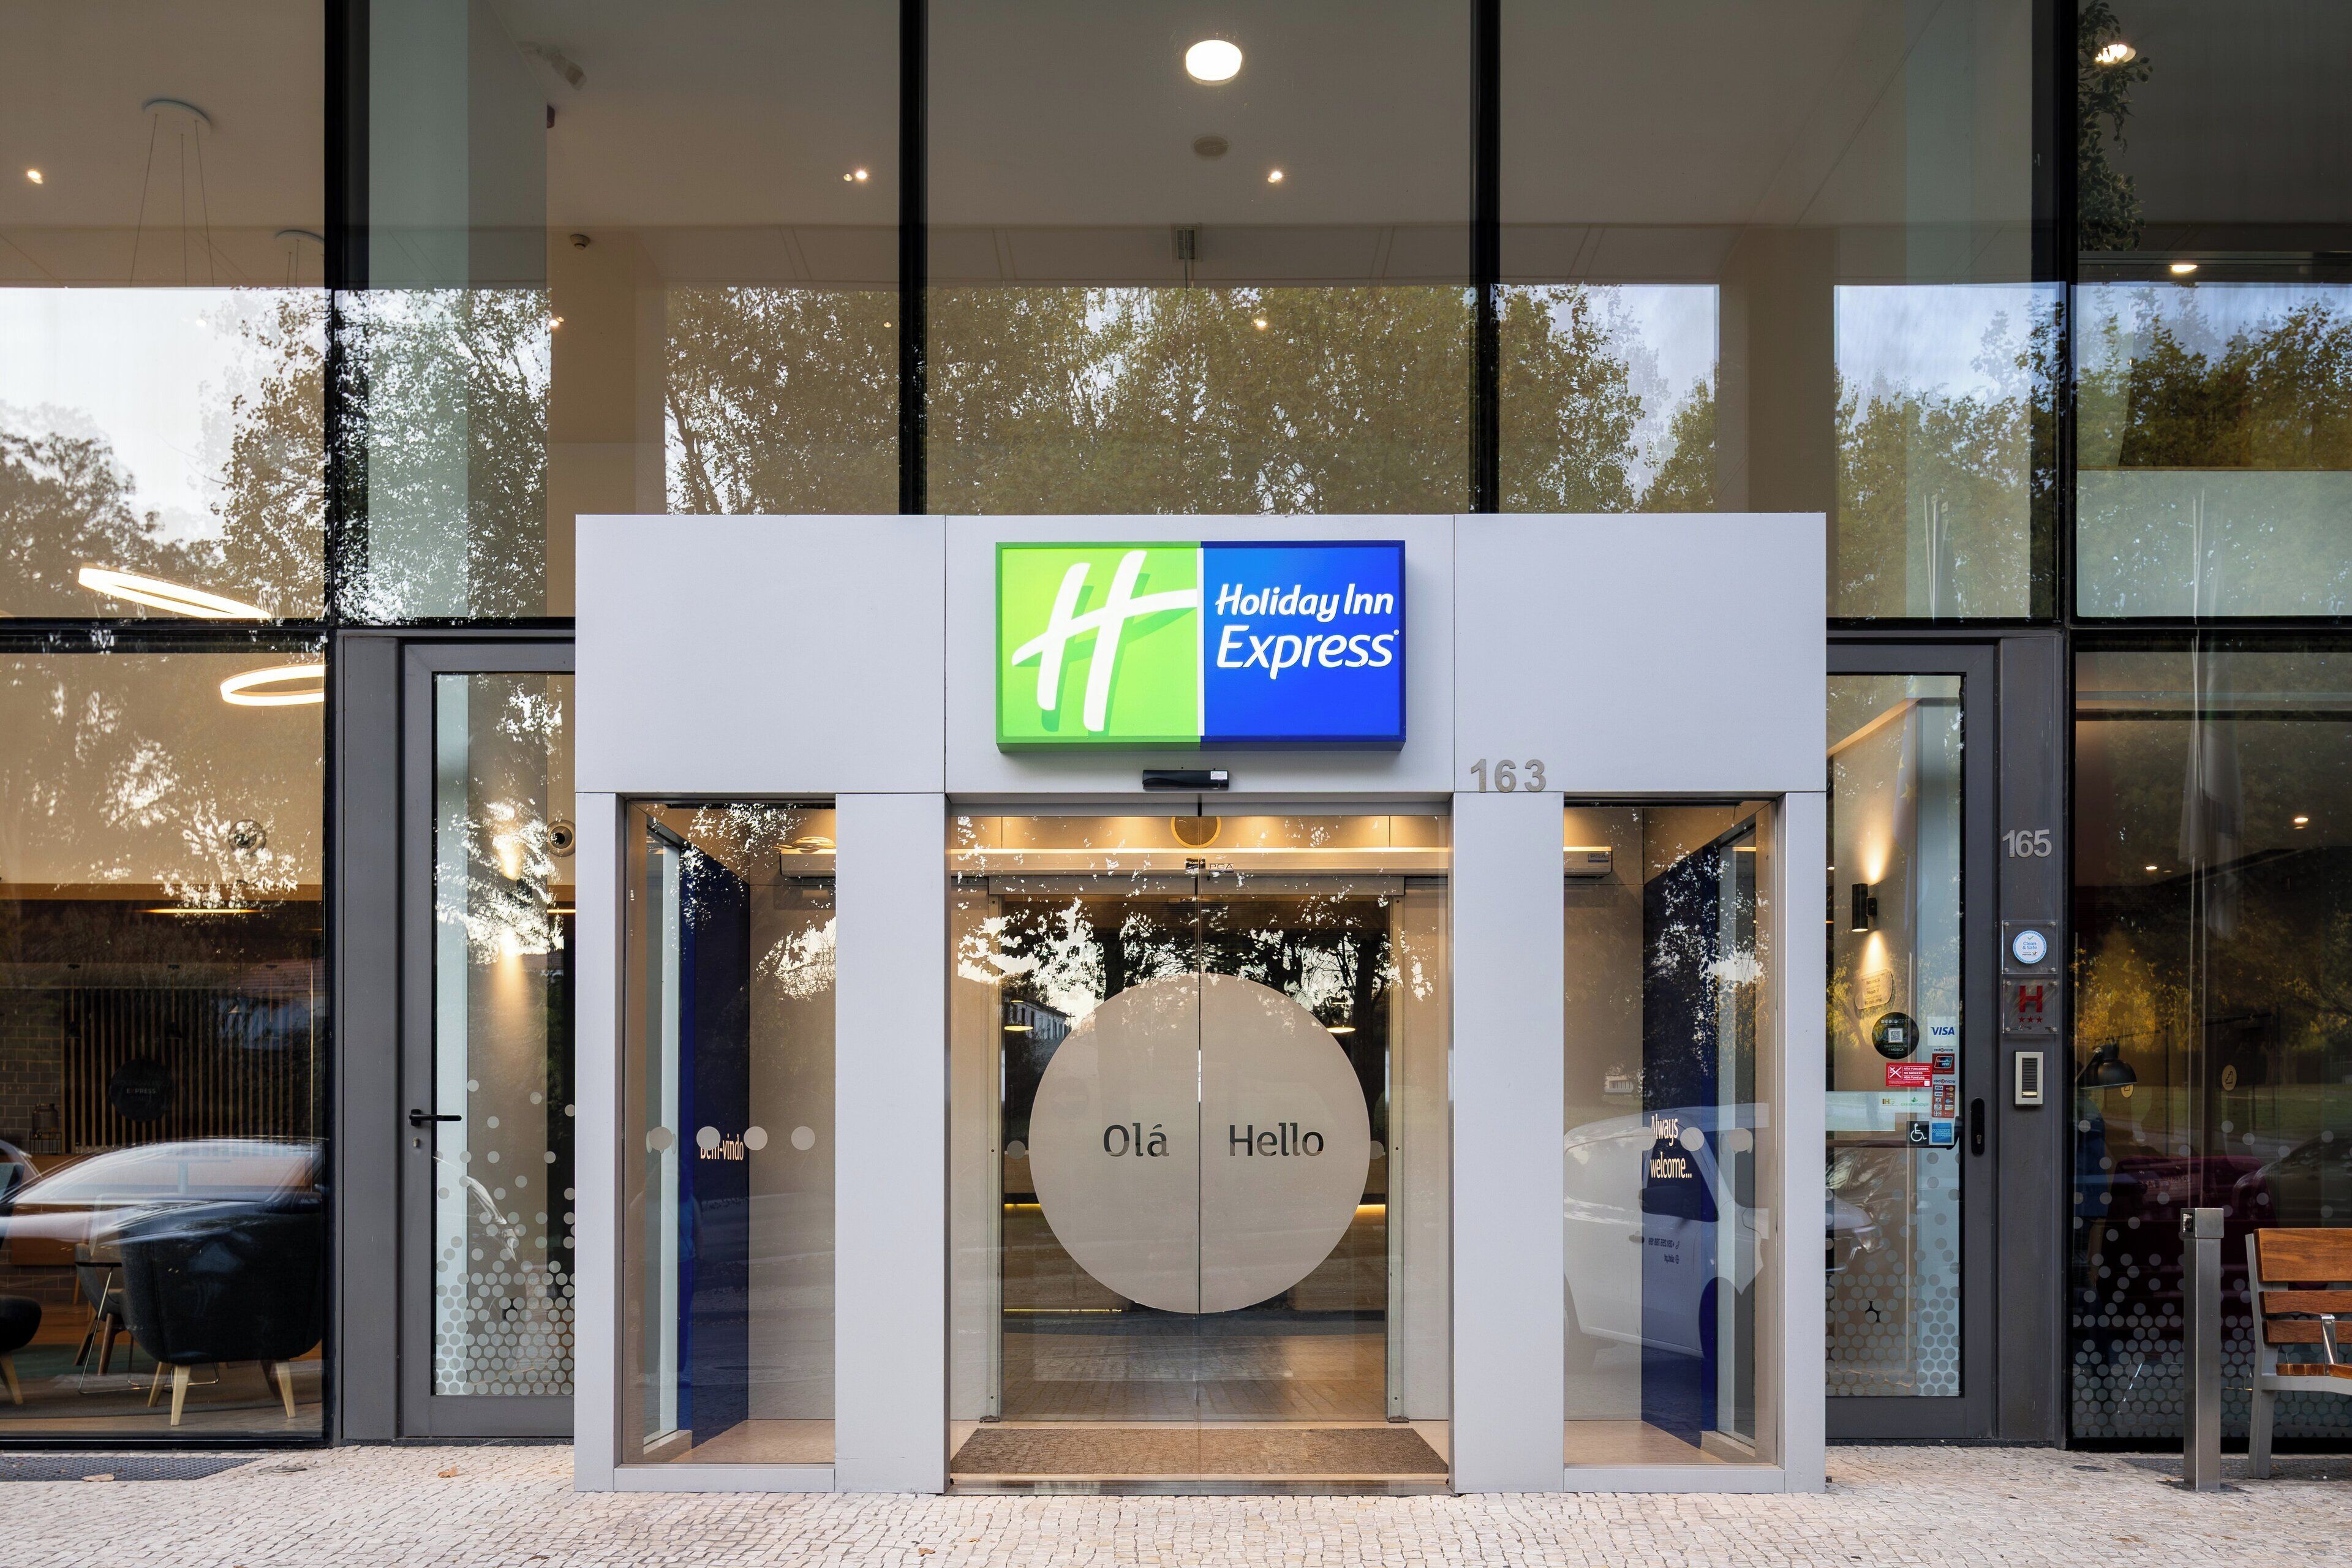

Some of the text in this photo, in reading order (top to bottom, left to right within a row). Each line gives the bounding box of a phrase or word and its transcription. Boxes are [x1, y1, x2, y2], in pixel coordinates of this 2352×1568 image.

[1215, 582, 1394, 623] Holiday Inn
[1216, 625, 1395, 680] Express
[1471, 759, 1547, 793] 163
[2002, 829, 2052, 858] 165
[1931, 1027, 1955, 1036] VISA
[1103, 1122, 1324, 1157] Olá Hello
[1651, 1113, 1678, 1146] Always
[1650, 1152, 1692, 1178] welcome...
